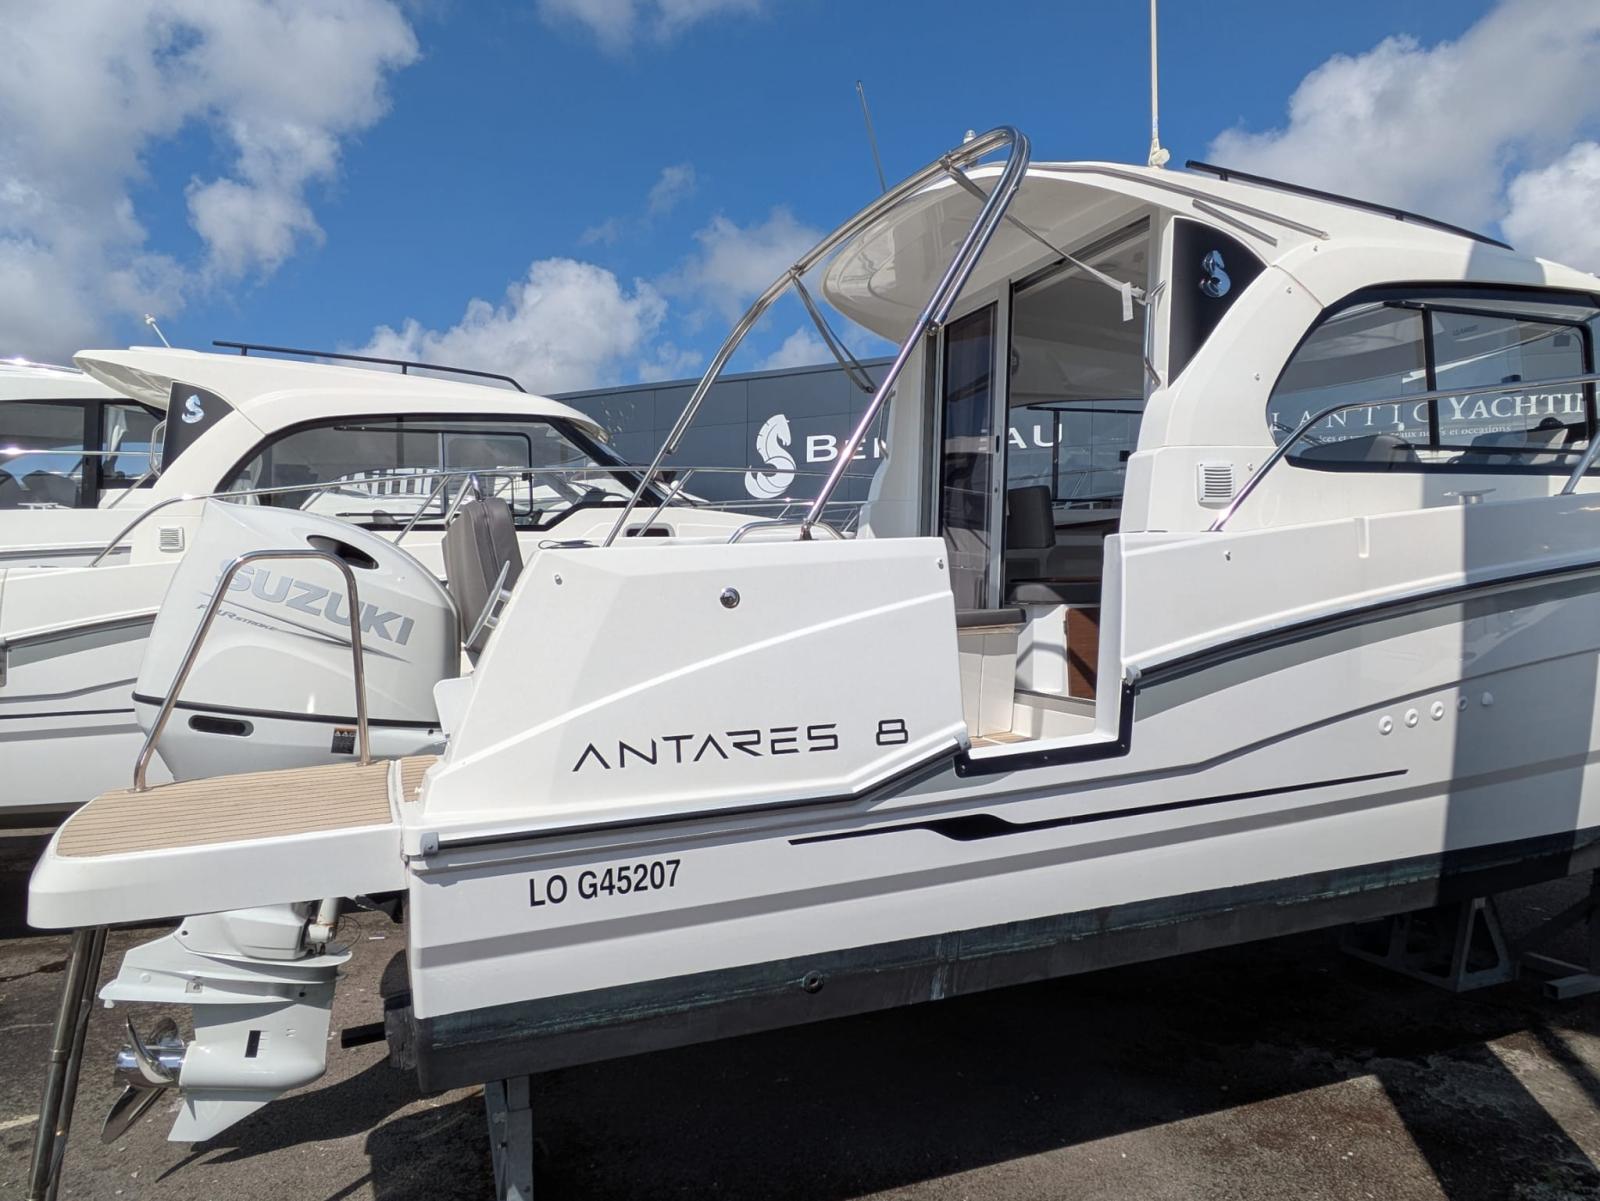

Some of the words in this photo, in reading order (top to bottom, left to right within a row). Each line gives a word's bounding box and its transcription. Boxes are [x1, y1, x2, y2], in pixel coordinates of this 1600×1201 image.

[215, 558, 415, 646] SUZUKI
[572, 723, 839, 772] ANTARES
[876, 718, 909, 746] 8
[529, 875, 568, 907] LO
[577, 859, 681, 900] G45207
